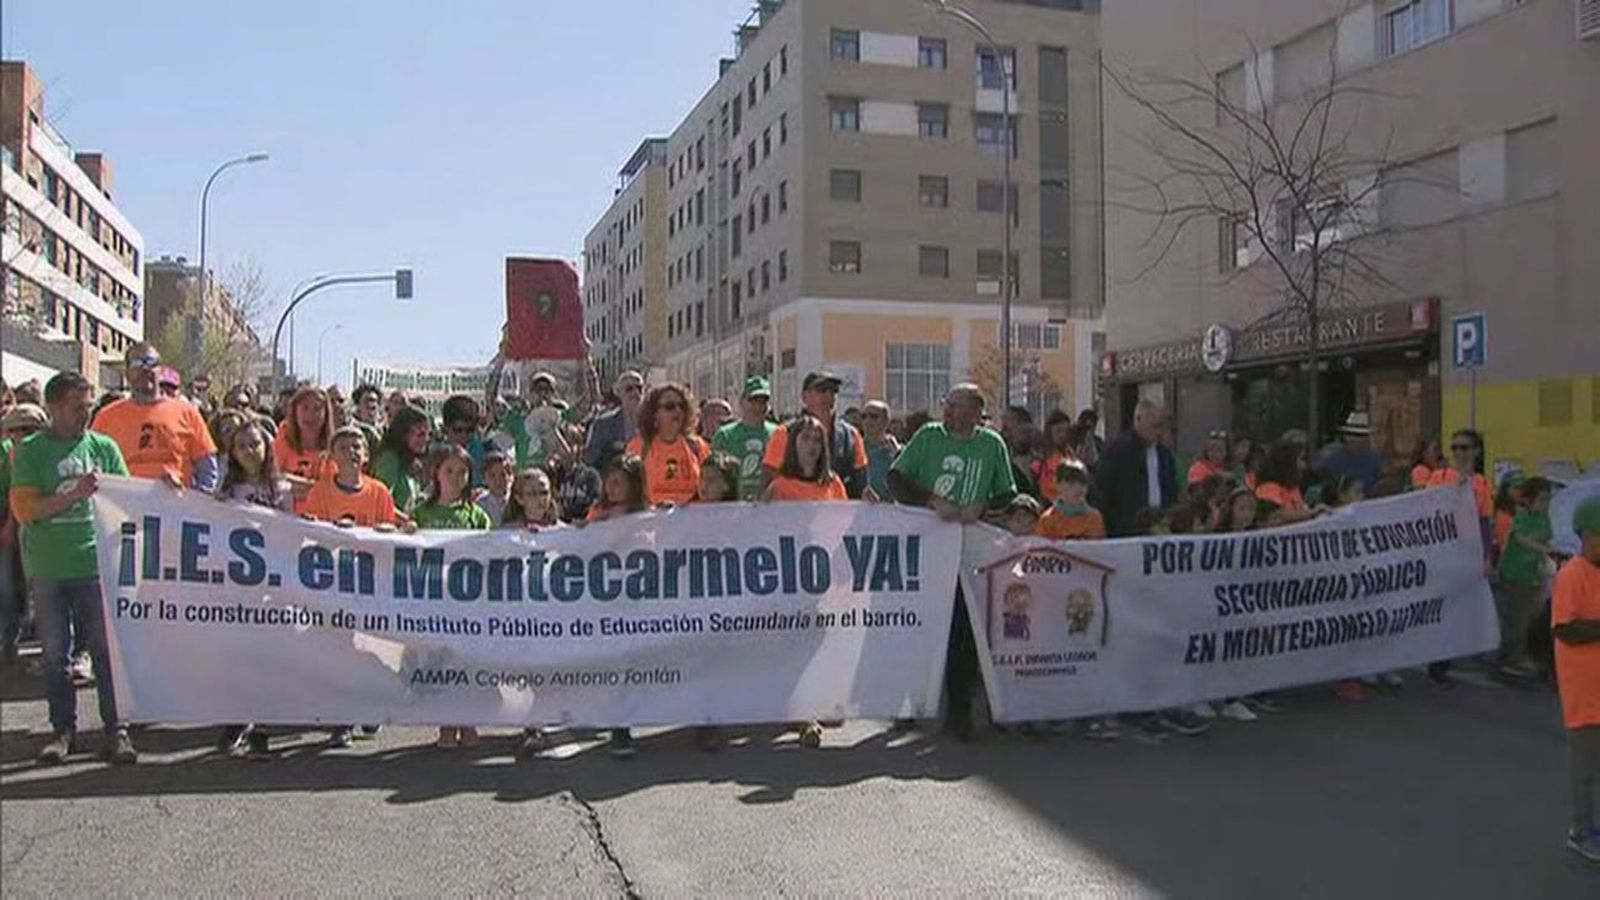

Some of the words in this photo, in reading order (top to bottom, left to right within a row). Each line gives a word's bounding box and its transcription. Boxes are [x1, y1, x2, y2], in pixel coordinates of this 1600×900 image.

[1456, 322, 1477, 364] P
[298, 544, 375, 595] en
[393, 535, 831, 602] Montecarmelo
[842, 534, 921, 593] YA!
[1142, 540, 1194, 575] POR
[1200, 538, 1236, 571] UN
[1239, 528, 1340, 569] INSTITUTO
[1341, 527, 1361, 559] DE
[1361, 509, 1458, 554] EDUCACIÓN
[1213, 574, 1348, 617] SECUNDARIA
[1351, 558, 1427, 599] PÚBLICO
[116, 598, 153, 619] Por
[159, 600, 177, 620] la
[185, 602, 324, 626] construcción
[331, 608, 356, 629] de
[364, 613, 389, 631] un
[396, 613, 481, 636] Instituto
[488, 615, 563, 637] Público
[569, 616, 593, 637] de
[601, 613, 704, 636] Educación
[709, 609, 810, 632] Secundaria
[816, 613, 836, 628] en
[840, 608, 857, 628] el
[862, 606, 922, 628] barrio.
[1184, 632, 1217, 665] EN
[1222, 608, 1388, 663] MONTECARMELO
[410, 668, 469, 687] AMPA
[475, 668, 544, 690] Colegio
[550, 668, 619, 687] Antonio
[624, 666, 681, 686] Fontán
